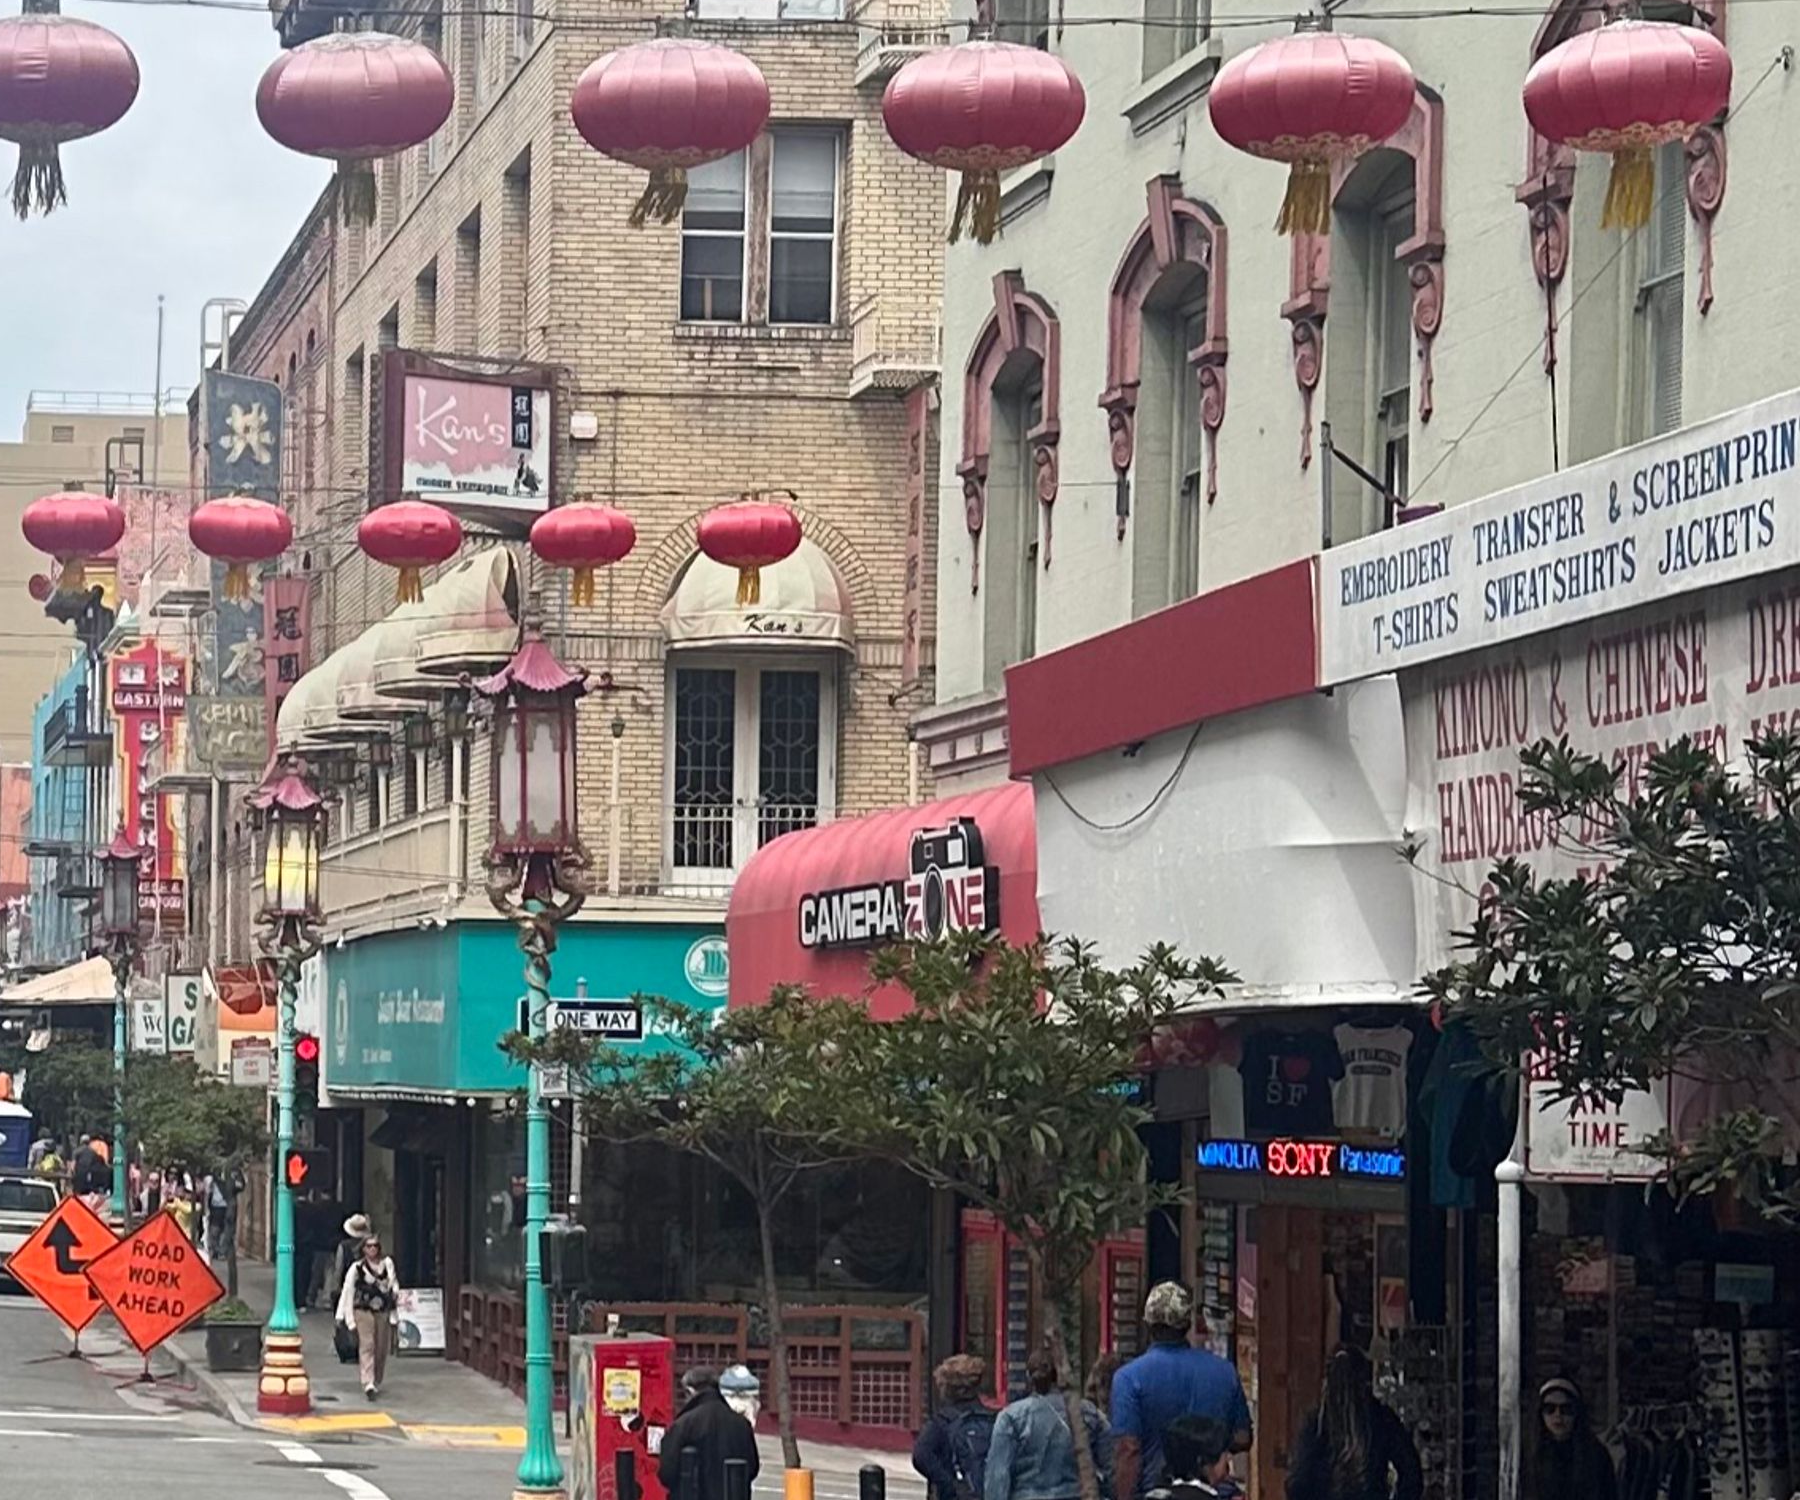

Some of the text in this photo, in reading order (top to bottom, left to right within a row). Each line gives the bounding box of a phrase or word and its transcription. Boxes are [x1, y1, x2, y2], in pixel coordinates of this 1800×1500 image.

[416, 385, 507, 454] Kan's
[1340, 534, 1454, 607] EMBROIDERY
[1473, 492, 1585, 566] TRANSFER
[1608, 481, 1622, 525] &
[1373, 498, 1775, 654] T-SHIRTS SWEATSHIRTS JACKETS
[1436, 656, 1529, 760] KIMONO
[1550, 653, 1568, 737] &
[1586, 610, 1708, 729] CHINESE
[801, 884, 900, 946] CAMERA
[554, 1011, 590, 1028] ONE
[595, 1011, 632, 1029] WAY
[1567, 1121, 1630, 1148] TIME
[1198, 1141, 1406, 1178] MINOLTA SONY Panasonic
[132, 1238, 186, 1263] ROAD
[128, 1265, 182, 1289] WORK
[116, 1293, 186, 1318] AHEAD
